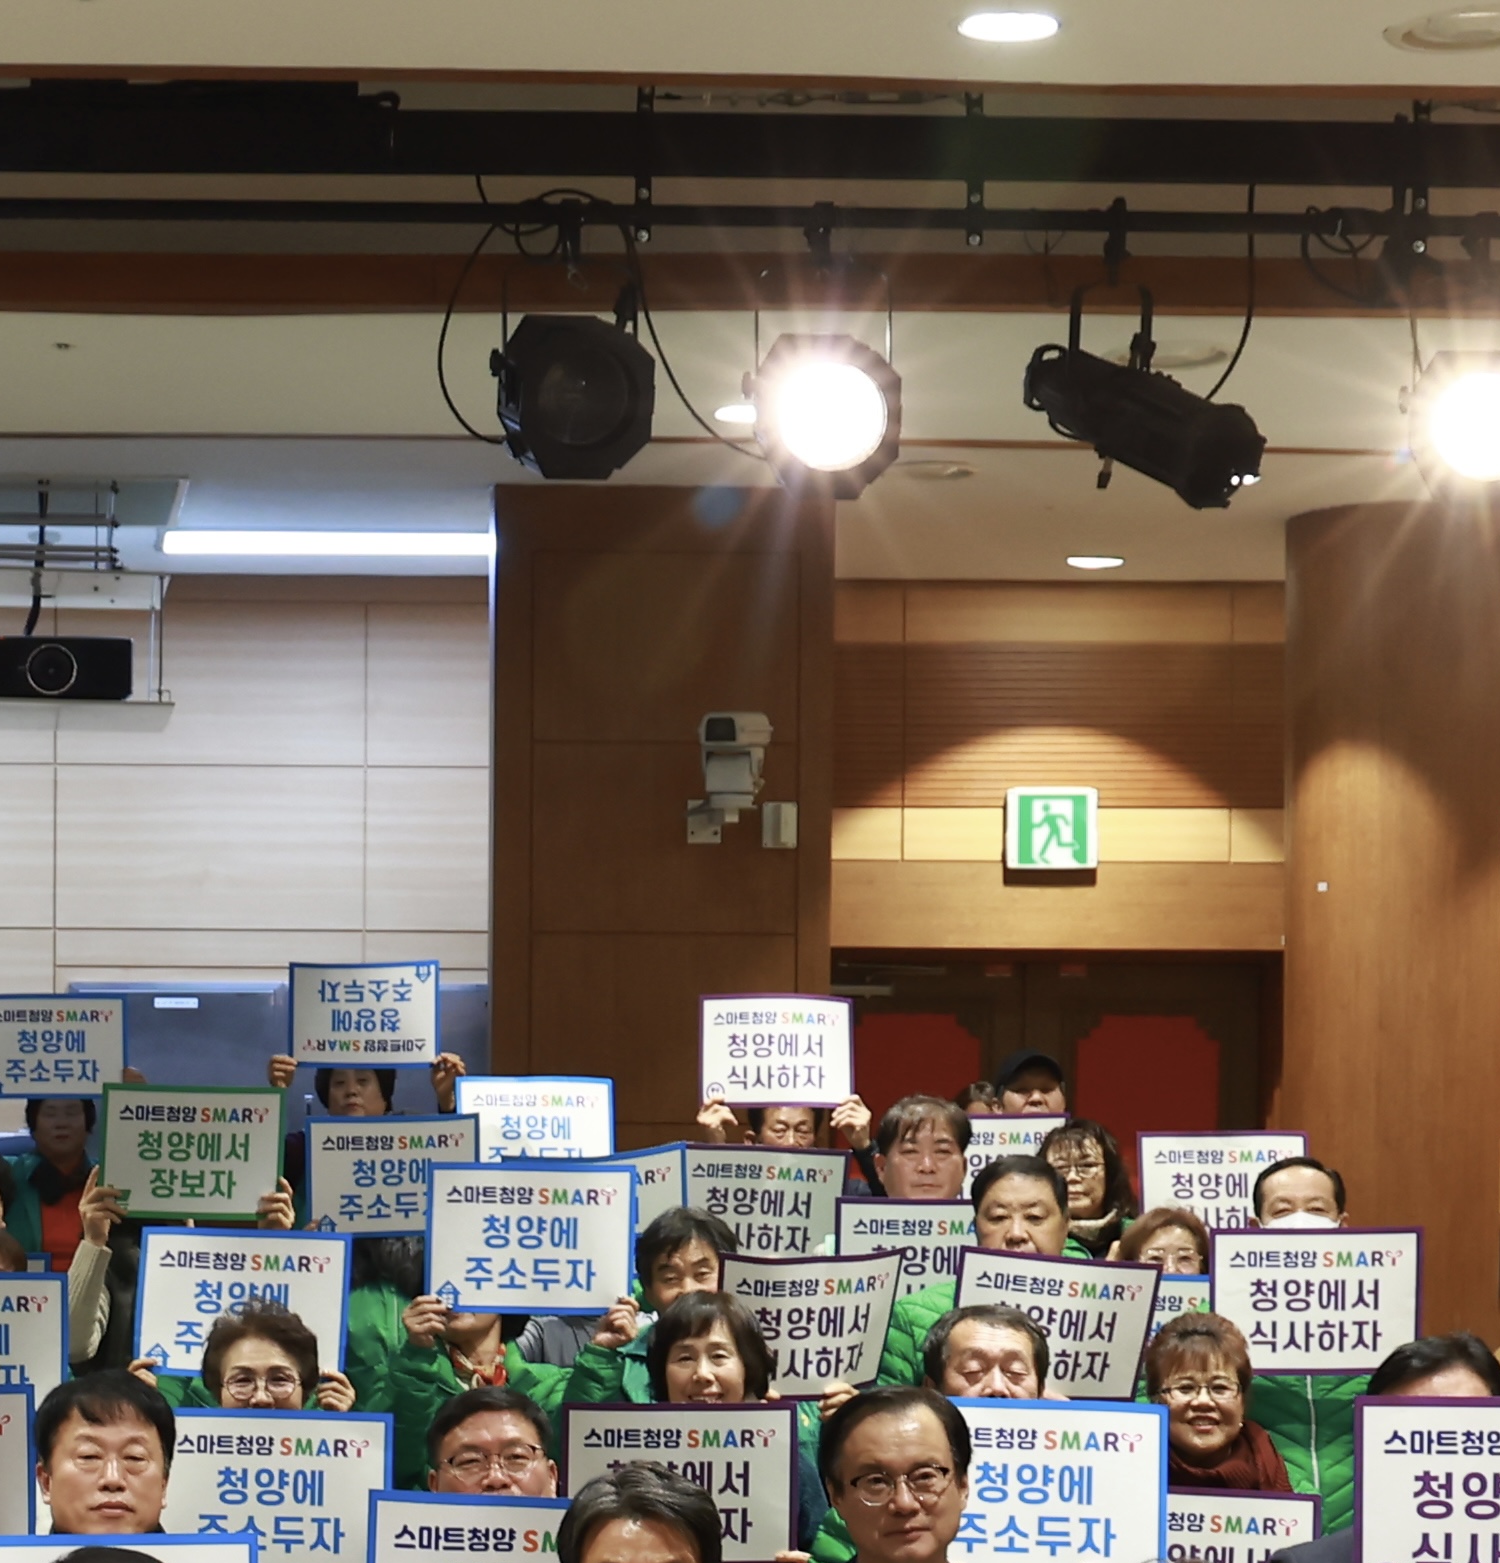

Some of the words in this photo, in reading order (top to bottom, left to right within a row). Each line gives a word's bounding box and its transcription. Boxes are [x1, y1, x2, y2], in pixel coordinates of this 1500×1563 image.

[318, 978, 411, 1004] 주소두자
[714, 1012, 777, 1025] 스마트청양
[18, 1030, 85, 1054] 청양에
[728, 1033, 823, 1058] 청양에서
[5, 1059, 99, 1083] 주소두자
[727, 1064, 825, 1090] 식사하자
[120, 1105, 197, 1123] 스마트청양
[501, 1115, 570, 1142] 청양에
[137, 1130, 249, 1162] 청양에서
[322, 1136, 394, 1151] 스마트청양
[1155, 1150, 1224, 1164] 스마트청양
[149, 1168, 236, 1199] 장보자
[692, 1163, 762, 1179] 스마트청양
[447, 1186, 534, 1205] 스마트청양
[705, 1186, 812, 1219] 청양에서
[482, 1214, 578, 1249] 청양에
[853, 1219, 933, 1236] 스마트청양
[160, 1251, 246, 1271] 스마트청양
[1230, 1251, 1317, 1268] 스마트청양
[464, 1257, 596, 1292] 주소두자
[976, 1271, 1064, 1296] 스마트청양
[736, 1278, 819, 1298] 스마트청양
[1250, 1279, 1379, 1312] 청양에서
[1249, 1320, 1382, 1353] 식사하자
[177, 1435, 274, 1456] 스마트청양
[584, 1428, 681, 1448] 스마트청양
[217, 1467, 324, 1506] 청양에
[975, 1461, 1093, 1505] 청양에
[394, 1525, 516, 1552] 스마트청양
